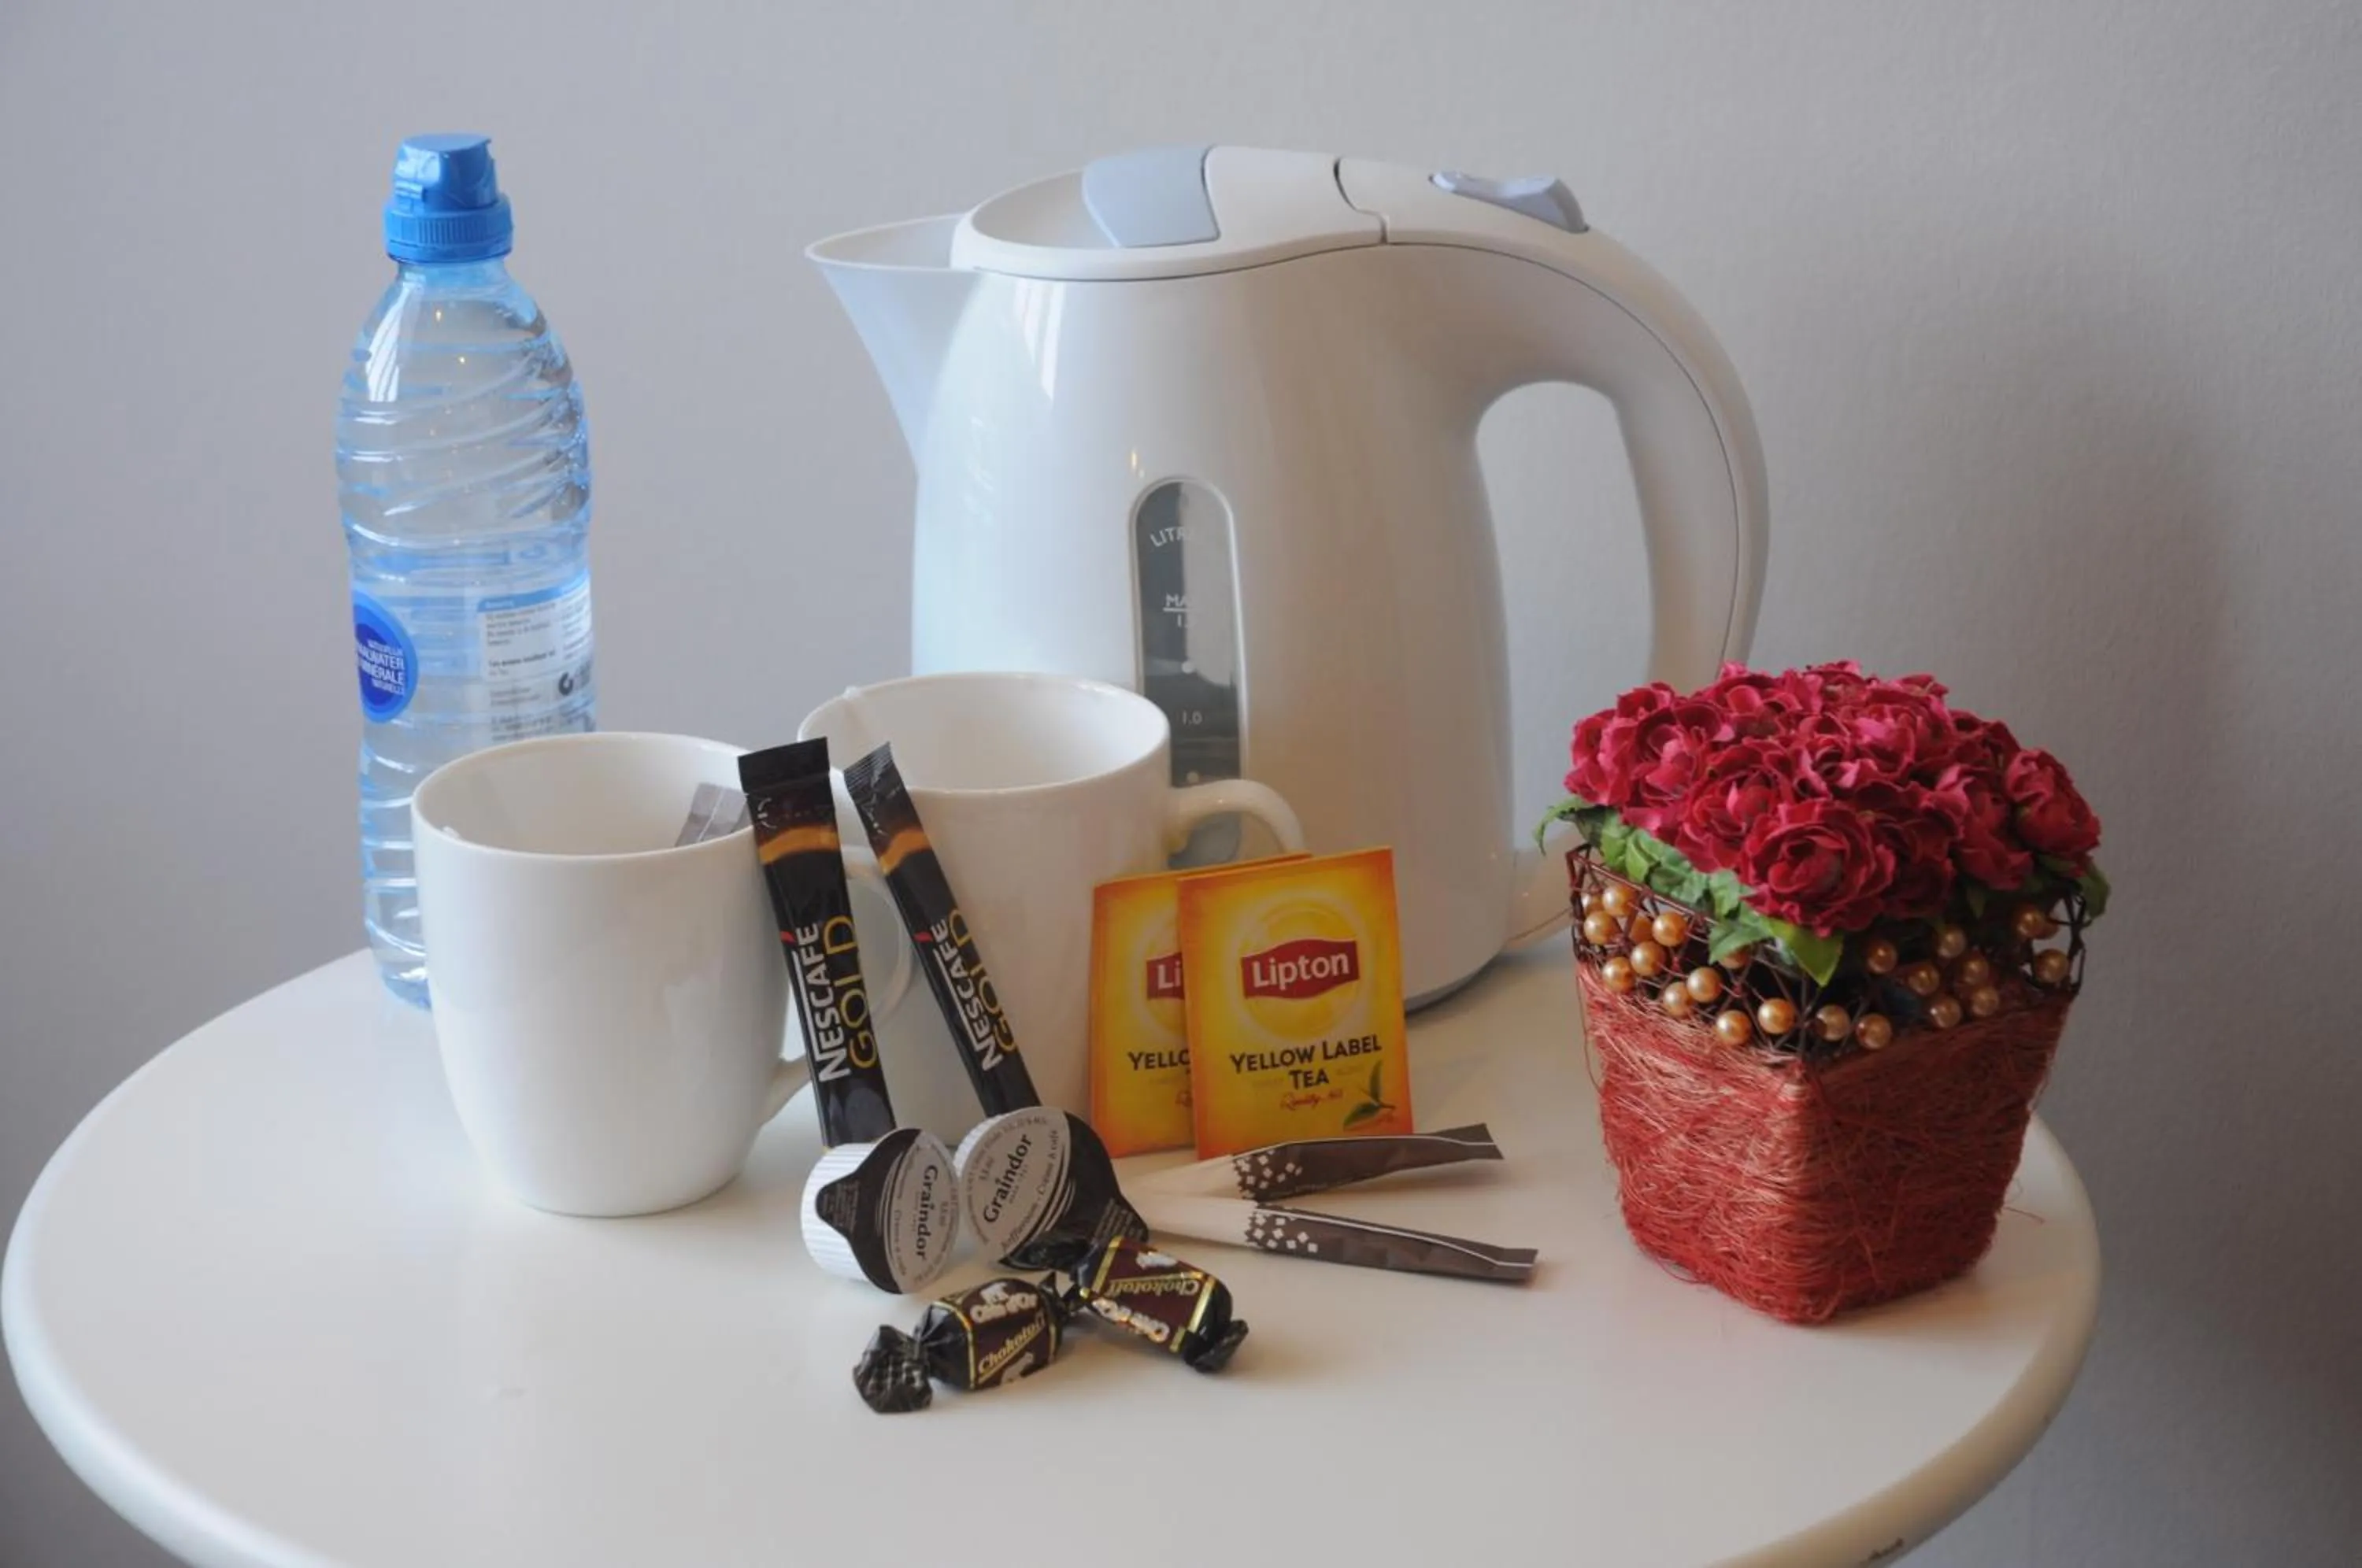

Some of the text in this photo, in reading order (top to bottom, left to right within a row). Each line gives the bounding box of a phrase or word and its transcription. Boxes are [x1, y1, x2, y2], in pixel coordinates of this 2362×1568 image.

[1183, 709, 1203, 725] 1.0
[1252, 952, 1349, 990] Lipton
[1127, 1048, 1190, 1071] YELLO
[1229, 1034, 1383, 1074] YELLOW LABEL
[1288, 1069, 1330, 1091] TEA
[983, 1133, 1032, 1223] Graindor
[916, 1164, 939, 1260] Graindor
[1104, 1279, 1200, 1298] Chokotoff
[978, 1308, 1046, 1374] Chokotoff
